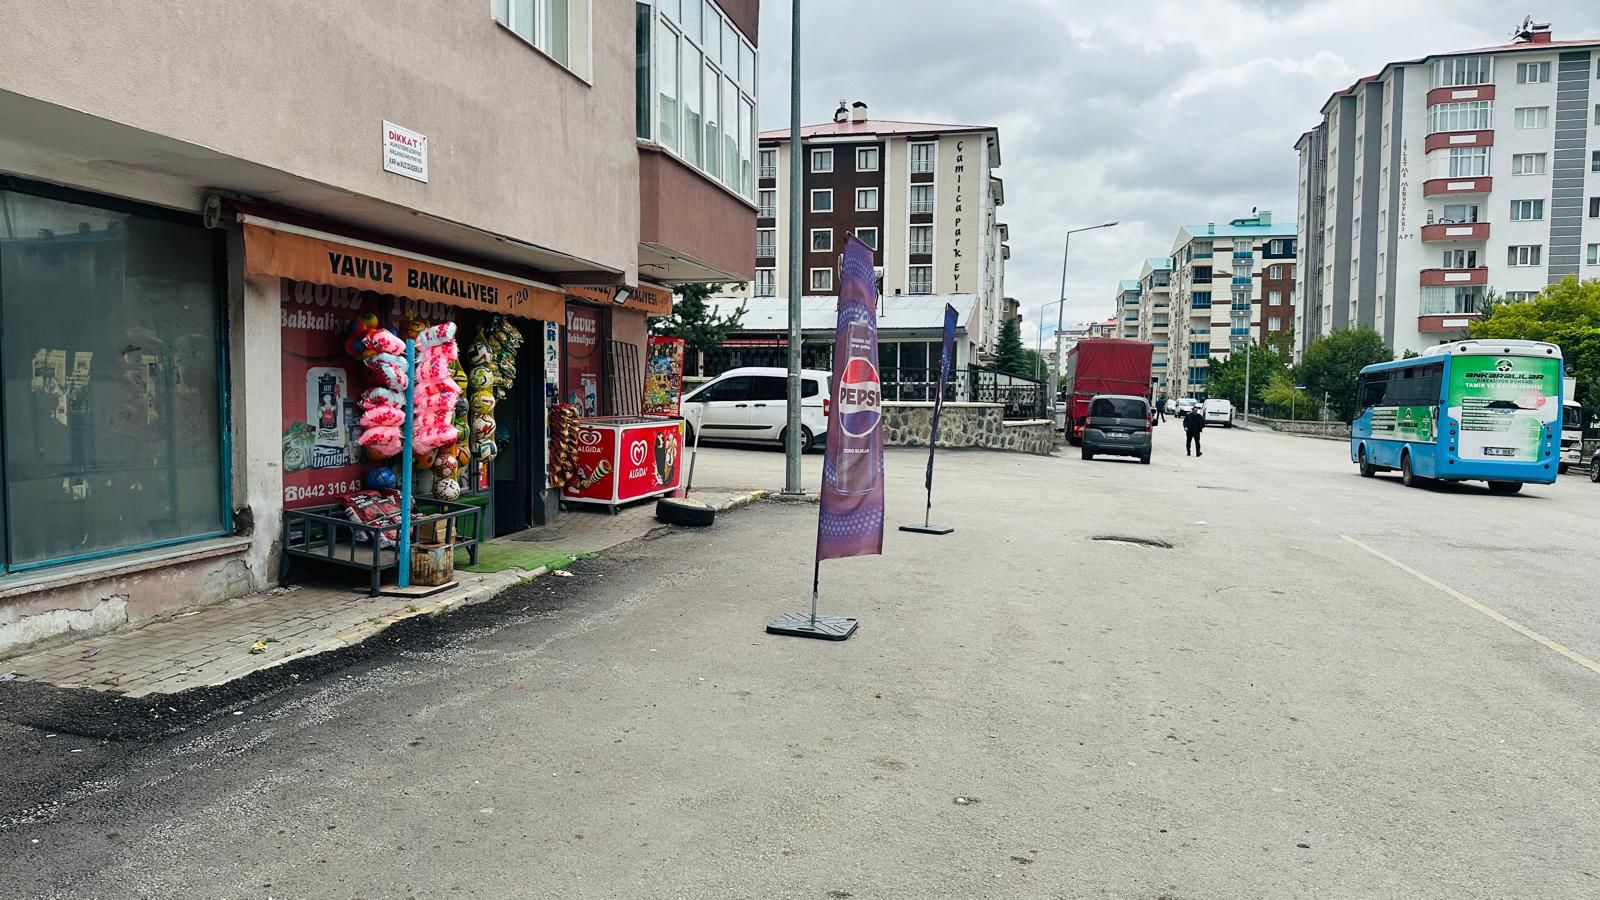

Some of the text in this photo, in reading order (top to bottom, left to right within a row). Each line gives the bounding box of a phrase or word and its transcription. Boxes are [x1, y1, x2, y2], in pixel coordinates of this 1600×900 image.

[388, 130, 418, 148] DİKKAT
[328, 252, 498, 305] YAVUZ BAKKALİYESİ
[506, 288, 529, 309] 7/20
[567, 311, 596, 334] Yavuz
[840, 386, 880, 408] PEPSI
[577, 445, 602, 454] ALGIDA
[628, 467, 647, 479] ALGIDA
[298, 479, 361, 500] 0442 316 43
